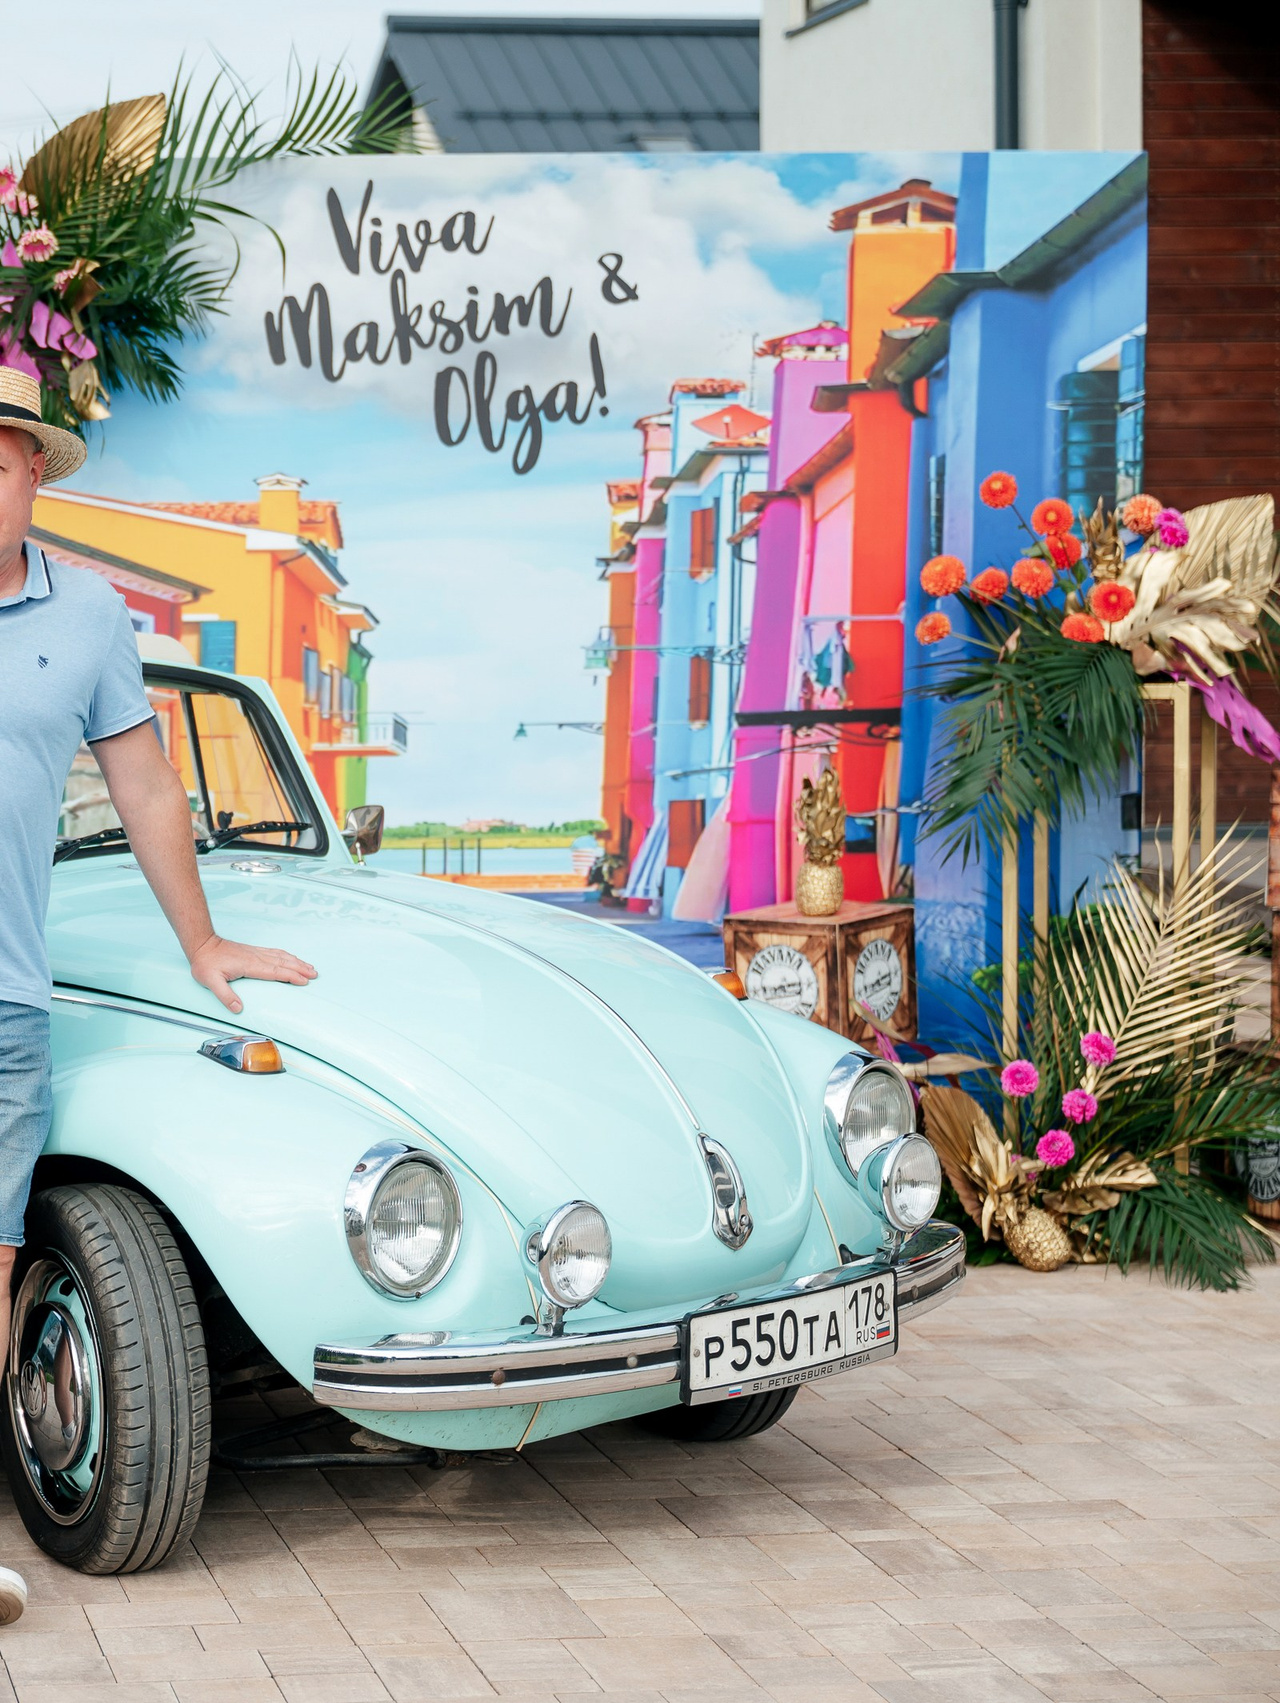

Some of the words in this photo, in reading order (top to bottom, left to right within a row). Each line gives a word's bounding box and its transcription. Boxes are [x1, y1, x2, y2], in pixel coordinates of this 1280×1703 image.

[327, 179, 495, 275] Viva
[264, 268, 572, 382] Maksim
[597, 252, 639, 304] &
[434, 332, 609, 475] Olga!
[751, 948, 803, 976] HAVANA
[857, 943, 892, 974] HAVANA
[848, 1282, 885, 1328] 178
[856, 1326, 876, 1345] RUS
[767, 1364, 833, 1388] PETERSBURG
[839, 1353, 871, 1370] RUSSIA
